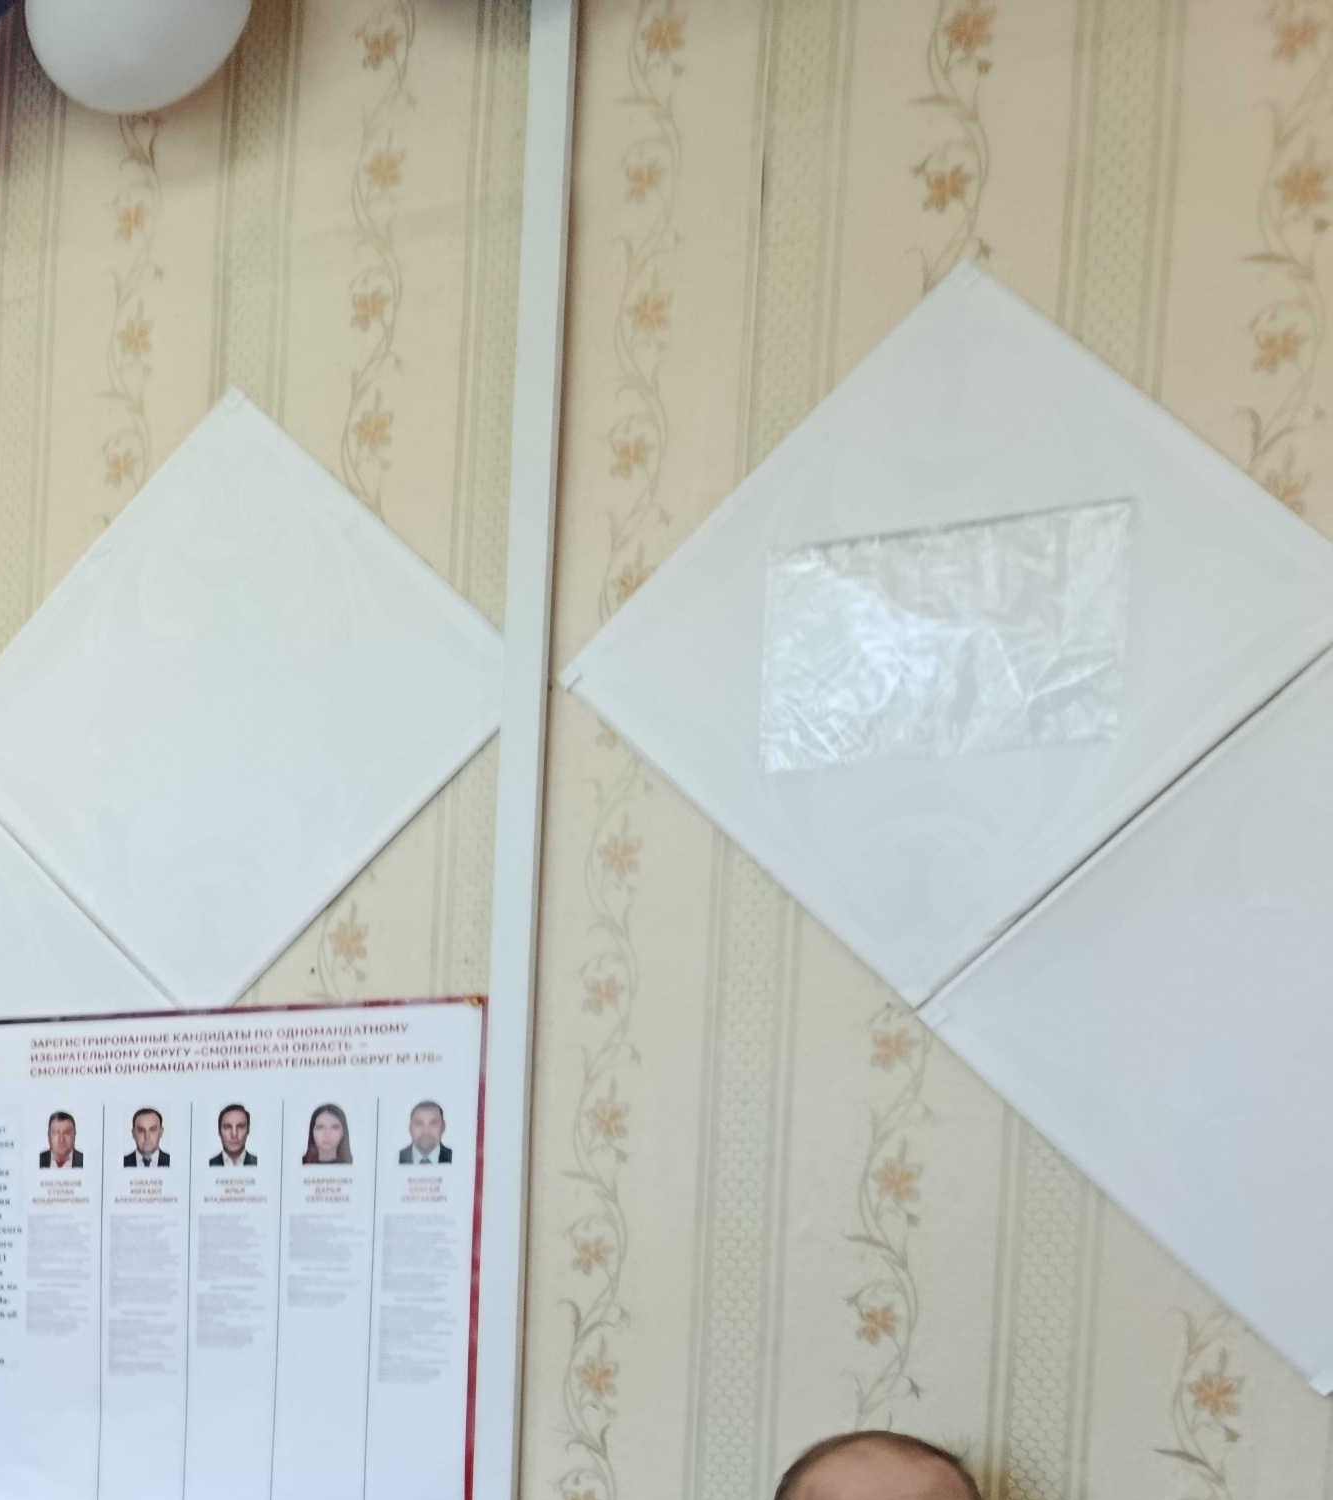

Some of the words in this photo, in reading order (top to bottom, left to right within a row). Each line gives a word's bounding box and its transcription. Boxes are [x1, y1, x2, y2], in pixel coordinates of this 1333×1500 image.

[30, 1034, 169, 1049] ЗАРЕГИСТРИРОВАННЫЕ
[173, 1030, 250, 1043] КАНДИДАТЫ
[254, 1029, 273, 1040] ПО
[277, 1023, 409, 1040] ОДНОМАНДАТНОМУ
[30, 1048, 140, 1064] ИЗБИРАТЕЛЬНОМУ
[144, 1046, 190, 1059] ОКРУГУ
[292, 1041, 352, 1053] ОБЛАСТЬ
[30, 1062, 112, 1078] СМОЛЕНСКИЙ
[115, 1058, 230, 1075] ОДНОМАНДАТНЫЙ
[233, 1054, 347, 1070] ИЗБИРАТЕЛЬНЫЙ
[351, 1055, 393, 1066] ОКРУГ
